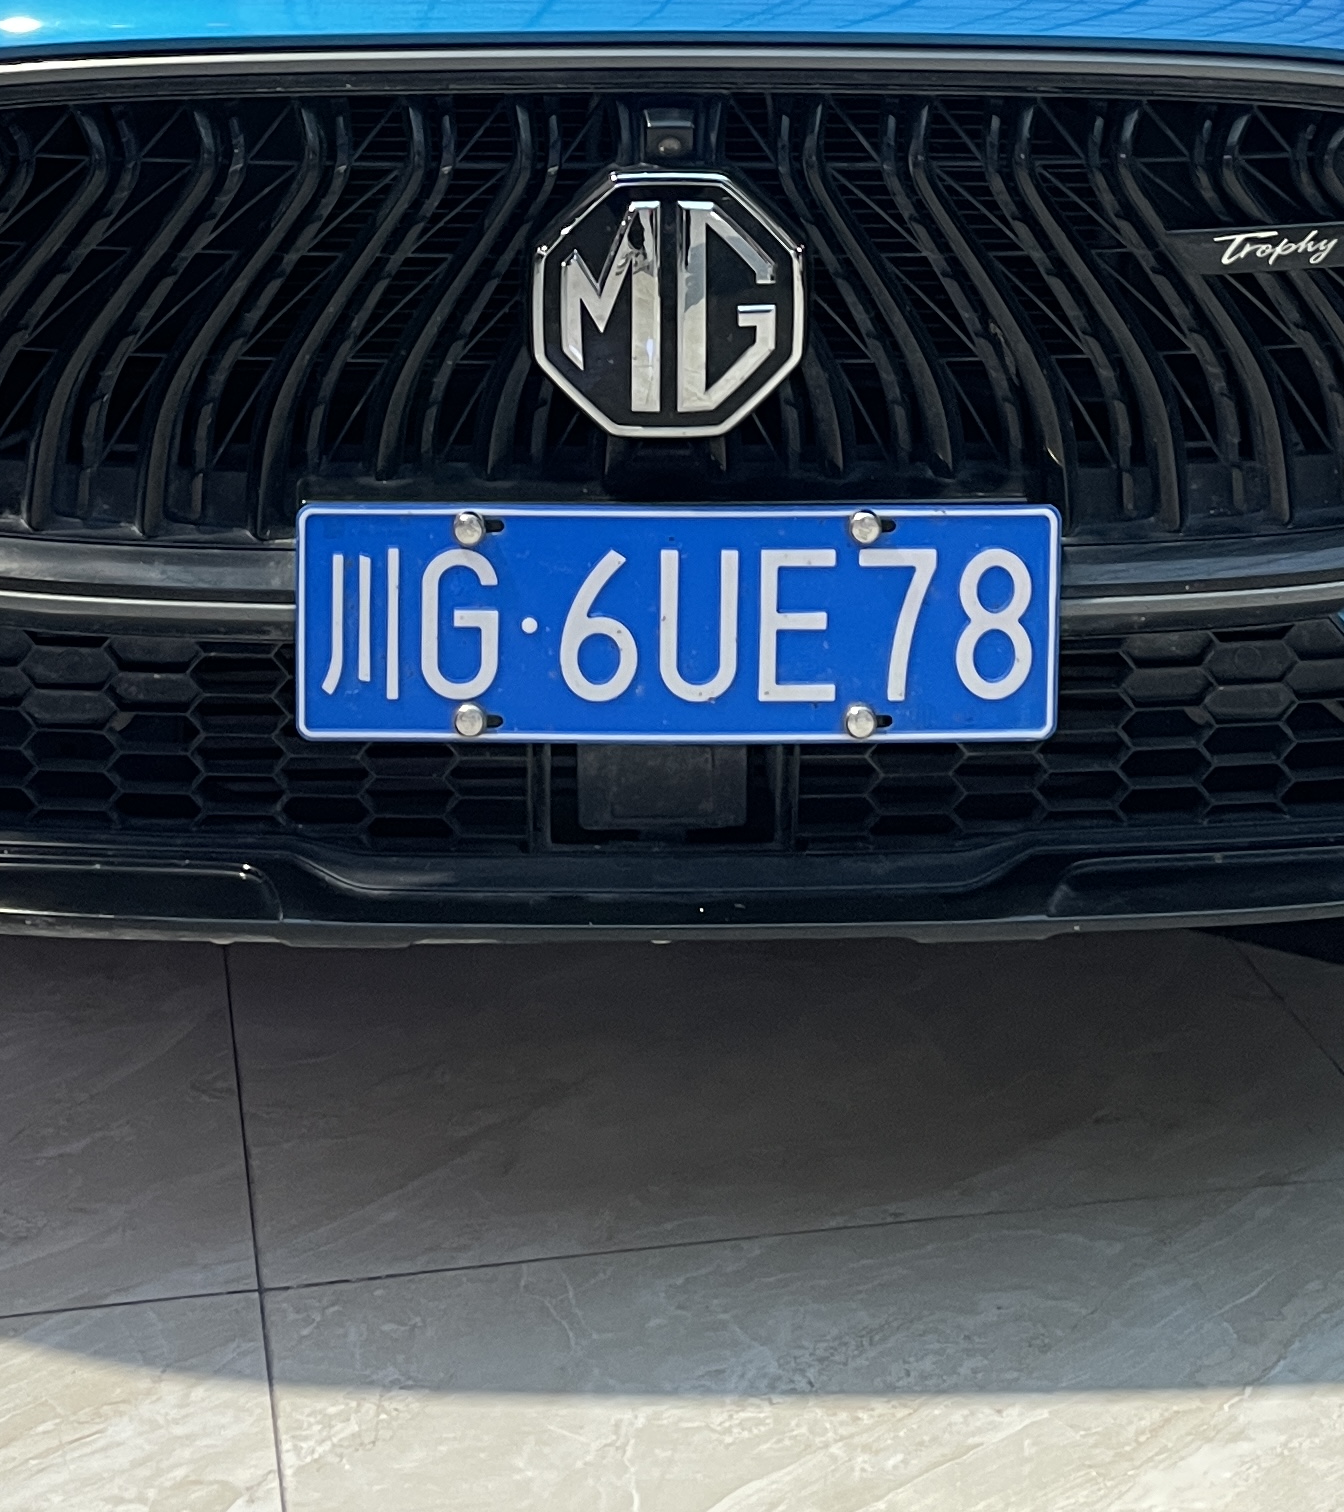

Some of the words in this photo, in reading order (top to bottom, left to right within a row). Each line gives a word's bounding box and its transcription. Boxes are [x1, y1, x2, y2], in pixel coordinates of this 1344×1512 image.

[561, 200, 777, 414] MG
[1215, 230, 1338, 264] Trophy
[321, 548, 1033, 703] 川G·6UE78
